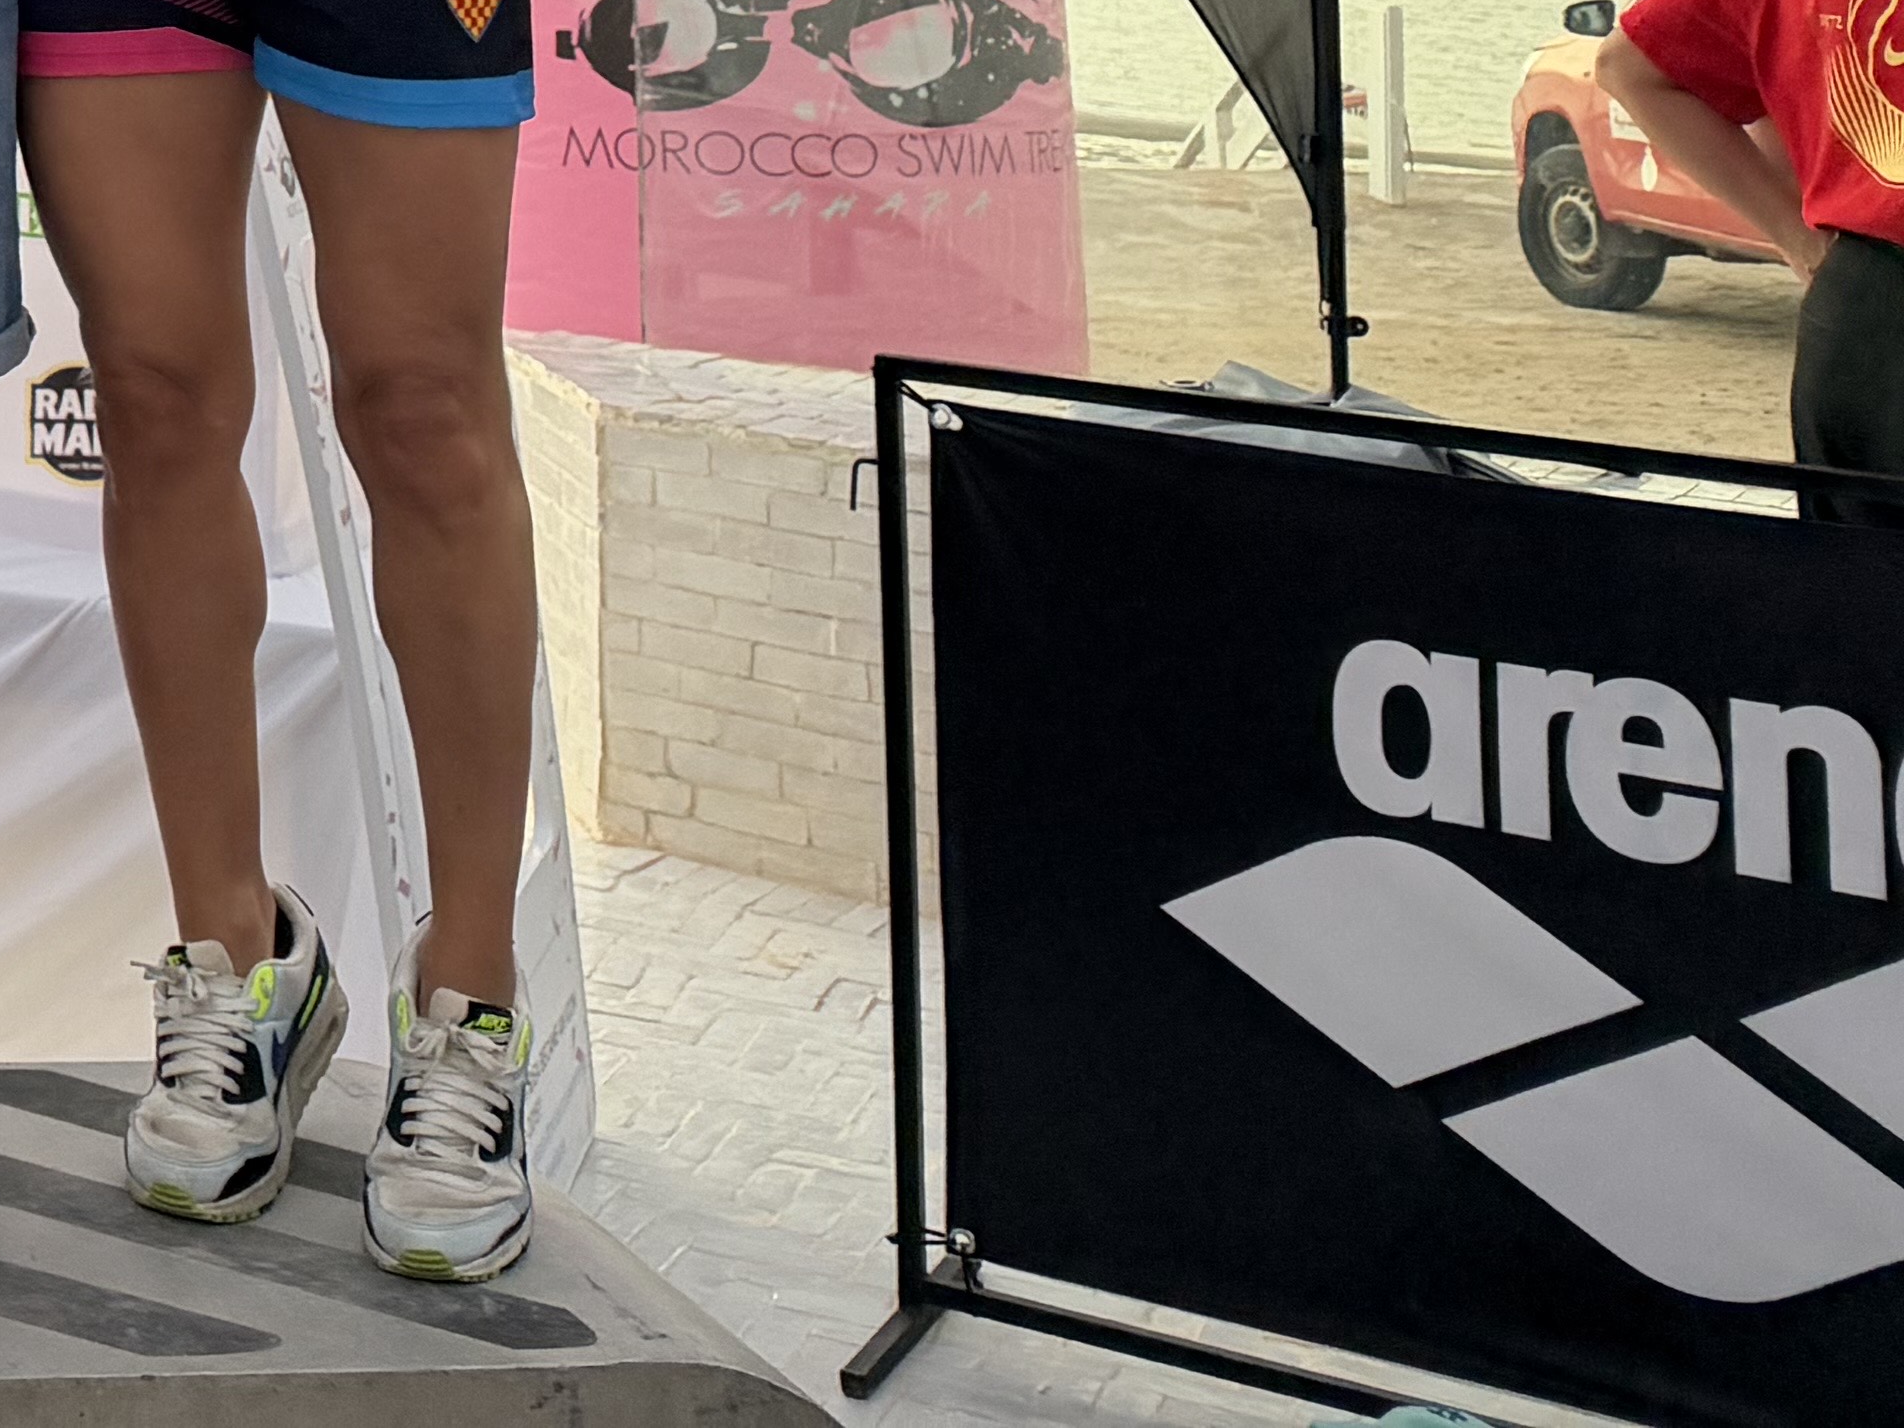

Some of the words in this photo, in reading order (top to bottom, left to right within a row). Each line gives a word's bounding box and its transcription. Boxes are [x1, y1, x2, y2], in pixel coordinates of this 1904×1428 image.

[562, 126, 879, 179] MOROCCO
[898, 131, 1017, 178] SWIM
[1028, 129, 1063, 176] TRE
[714, 189, 990, 220] SAHARA
[1332, 639, 1904, 901] aren
